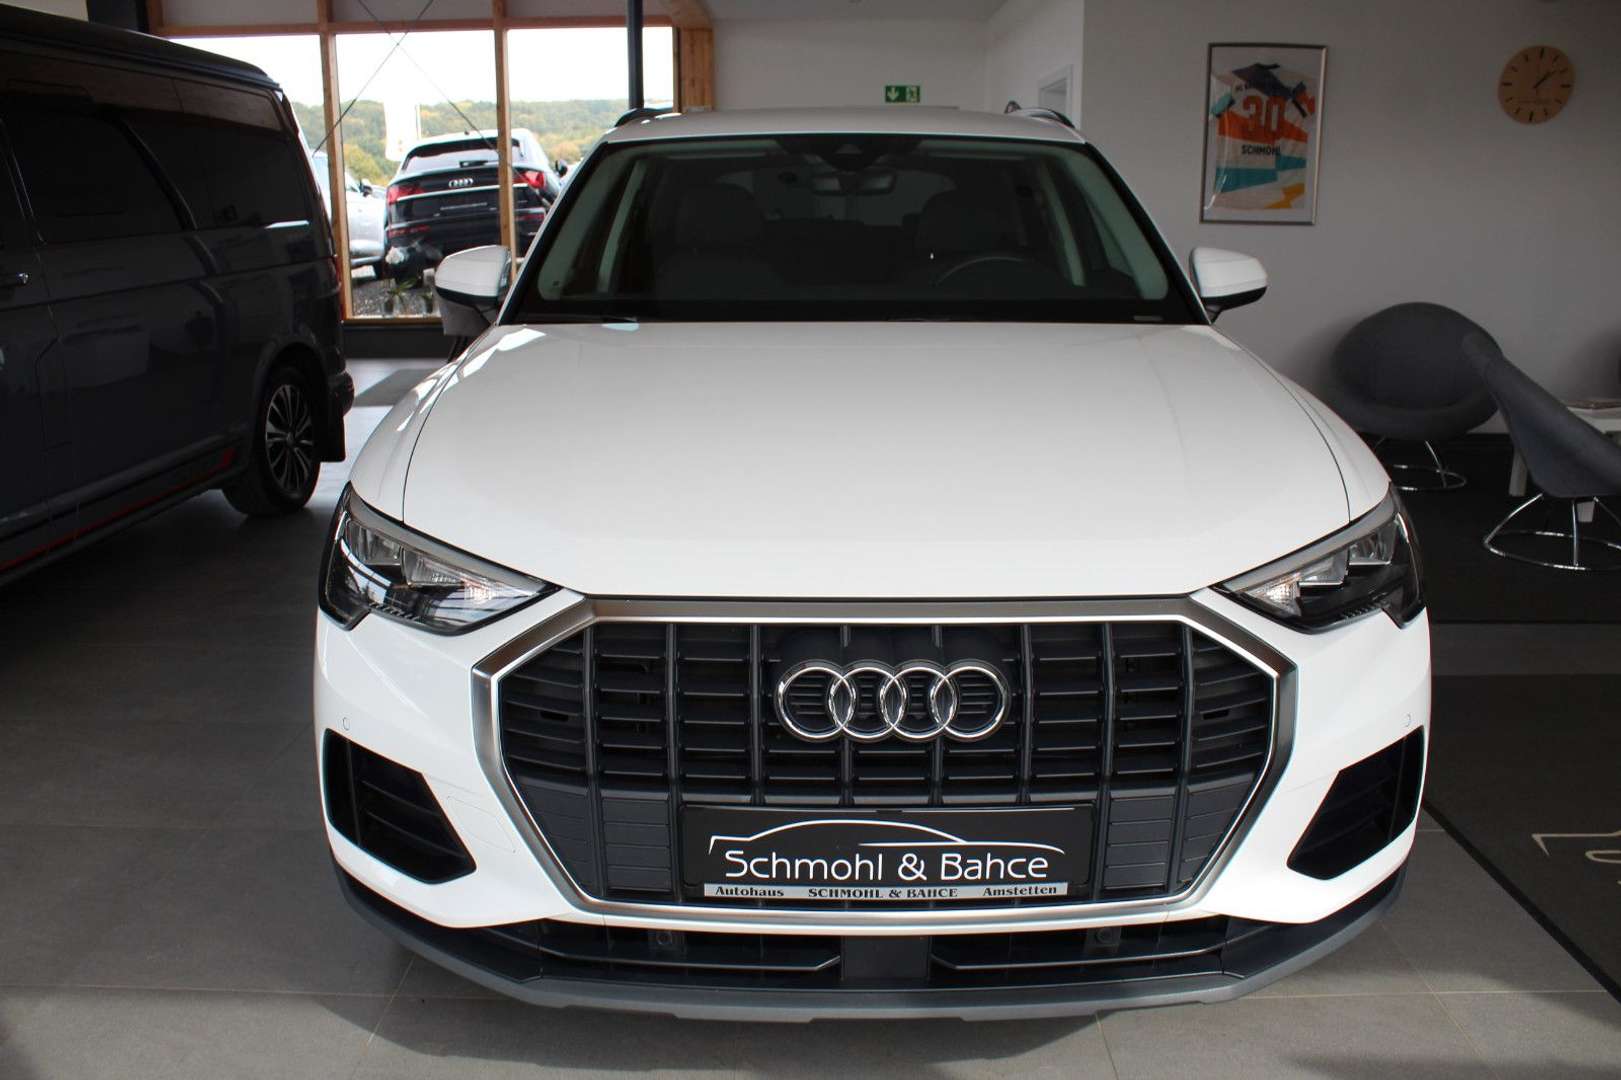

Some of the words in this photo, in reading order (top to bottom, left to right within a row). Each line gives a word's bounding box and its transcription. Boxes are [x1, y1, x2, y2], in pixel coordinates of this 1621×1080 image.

[725, 850, 883, 881] Schmohl
[897, 852, 928, 881] &
[940, 852, 1049, 881] Bahce
[715, 886, 785, 897] Autohaus
[808, 888, 883, 898] SCHMOHL
[888, 888, 902, 898] &
[906, 888, 958, 898] BAHCE
[982, 885, 1057, 897] Amstetten
